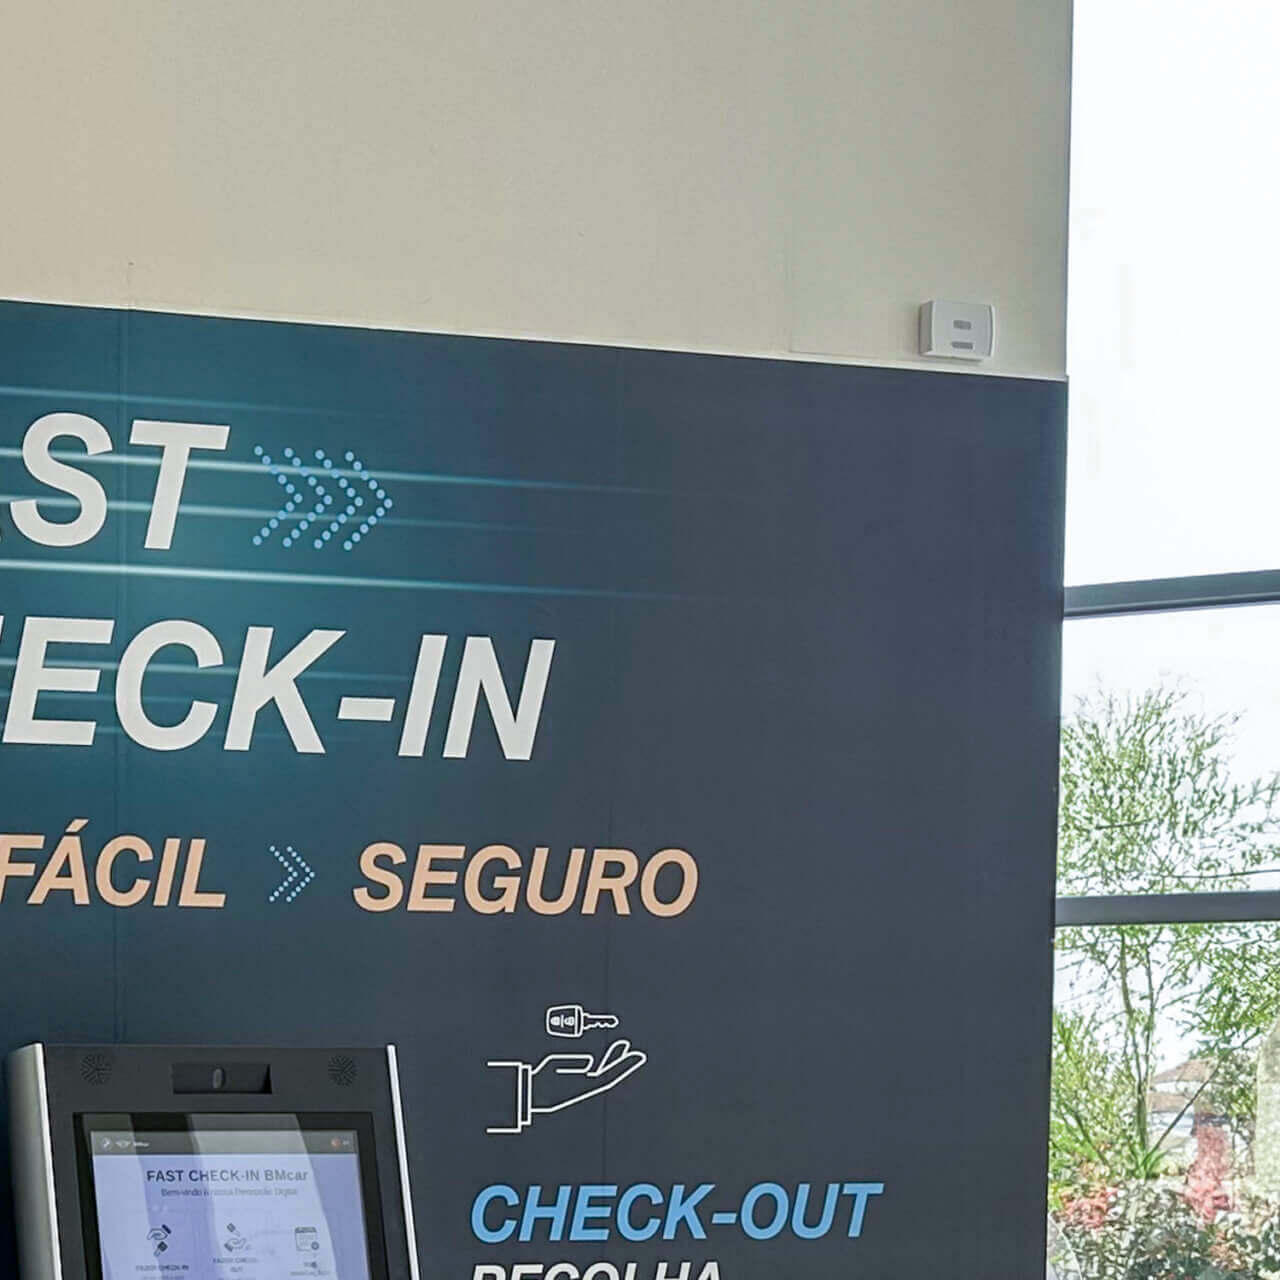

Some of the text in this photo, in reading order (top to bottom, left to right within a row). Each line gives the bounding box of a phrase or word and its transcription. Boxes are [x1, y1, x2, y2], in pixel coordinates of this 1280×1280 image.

[353, 842, 698, 917] SEGURO
[146, 1169, 309, 1182] FAST CHECK-IN BMcar
[471, 1182, 884, 1243] CHECK-OUT
